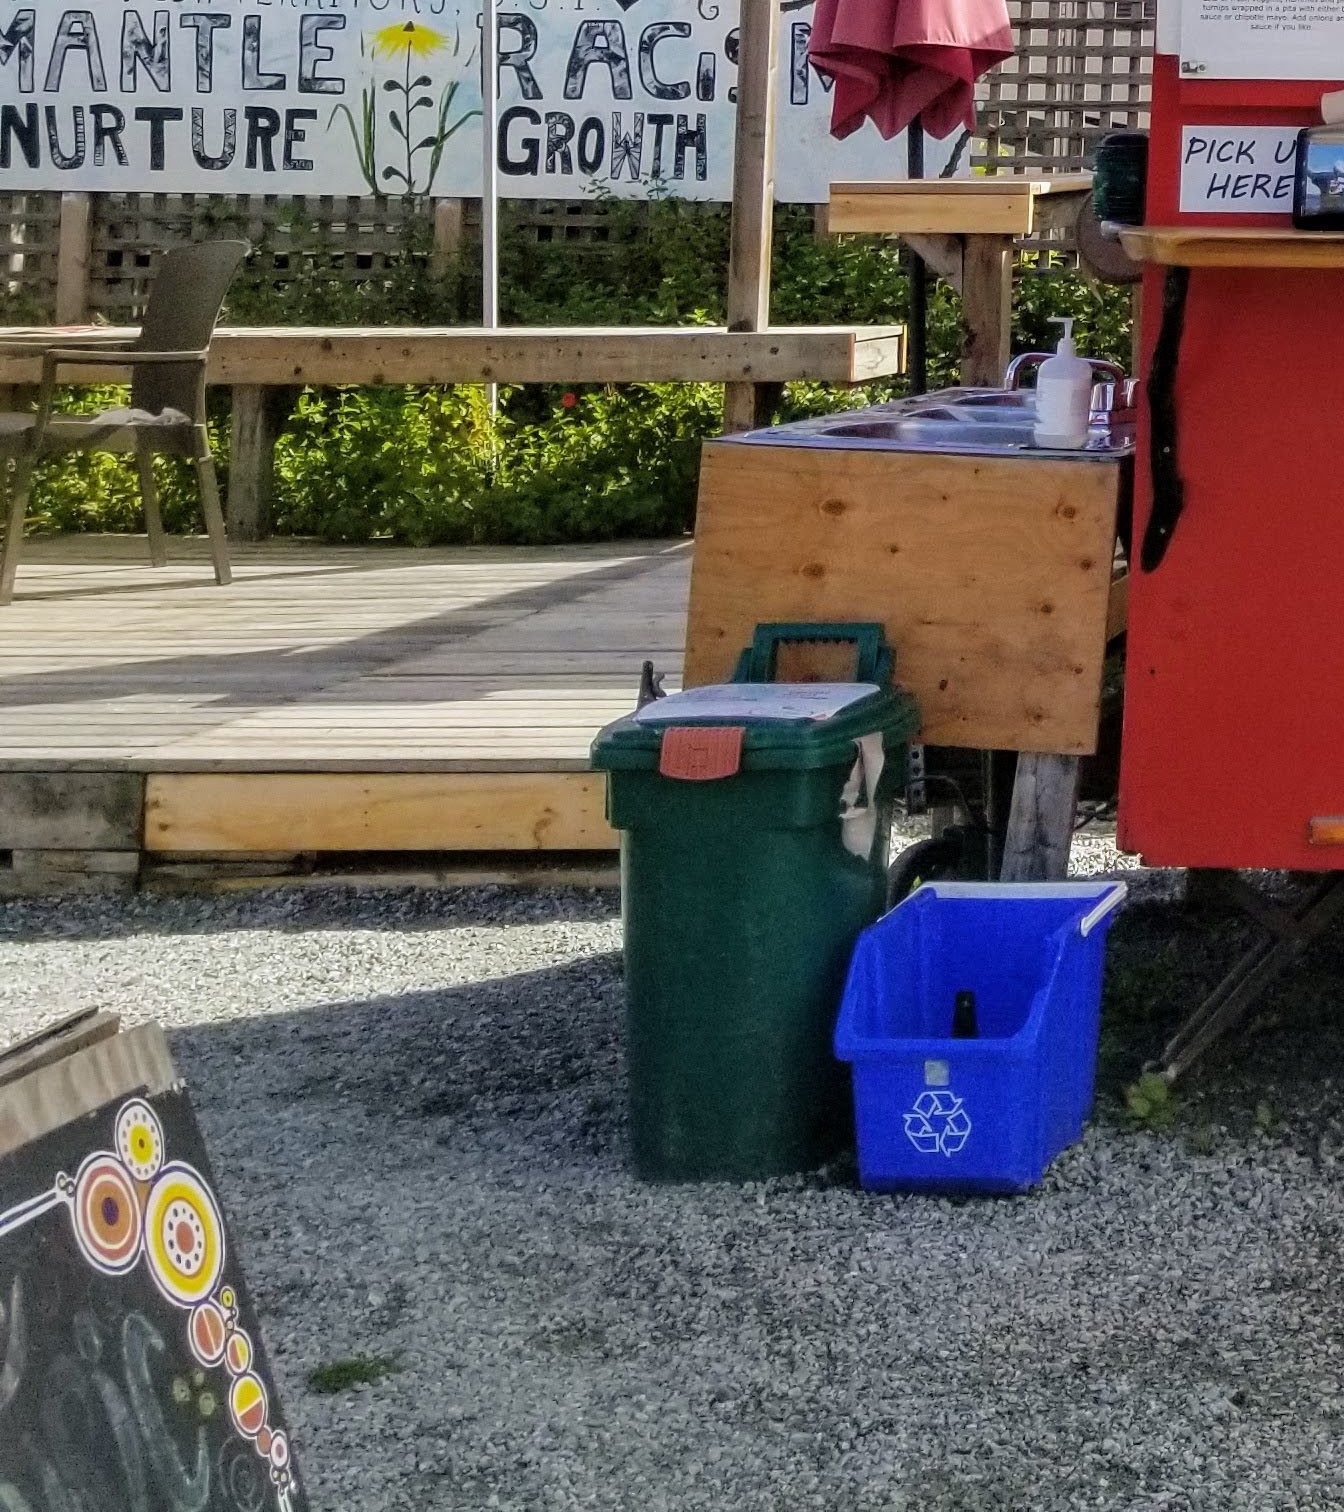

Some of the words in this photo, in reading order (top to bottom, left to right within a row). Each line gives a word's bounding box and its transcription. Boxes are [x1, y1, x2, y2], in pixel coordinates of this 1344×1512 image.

[0, 103, 318, 172] NURTURE
[498, 106, 707, 181] GROWTH
[1185, 137, 1256, 164] PICK
[1206, 173, 1296, 199] HERE
